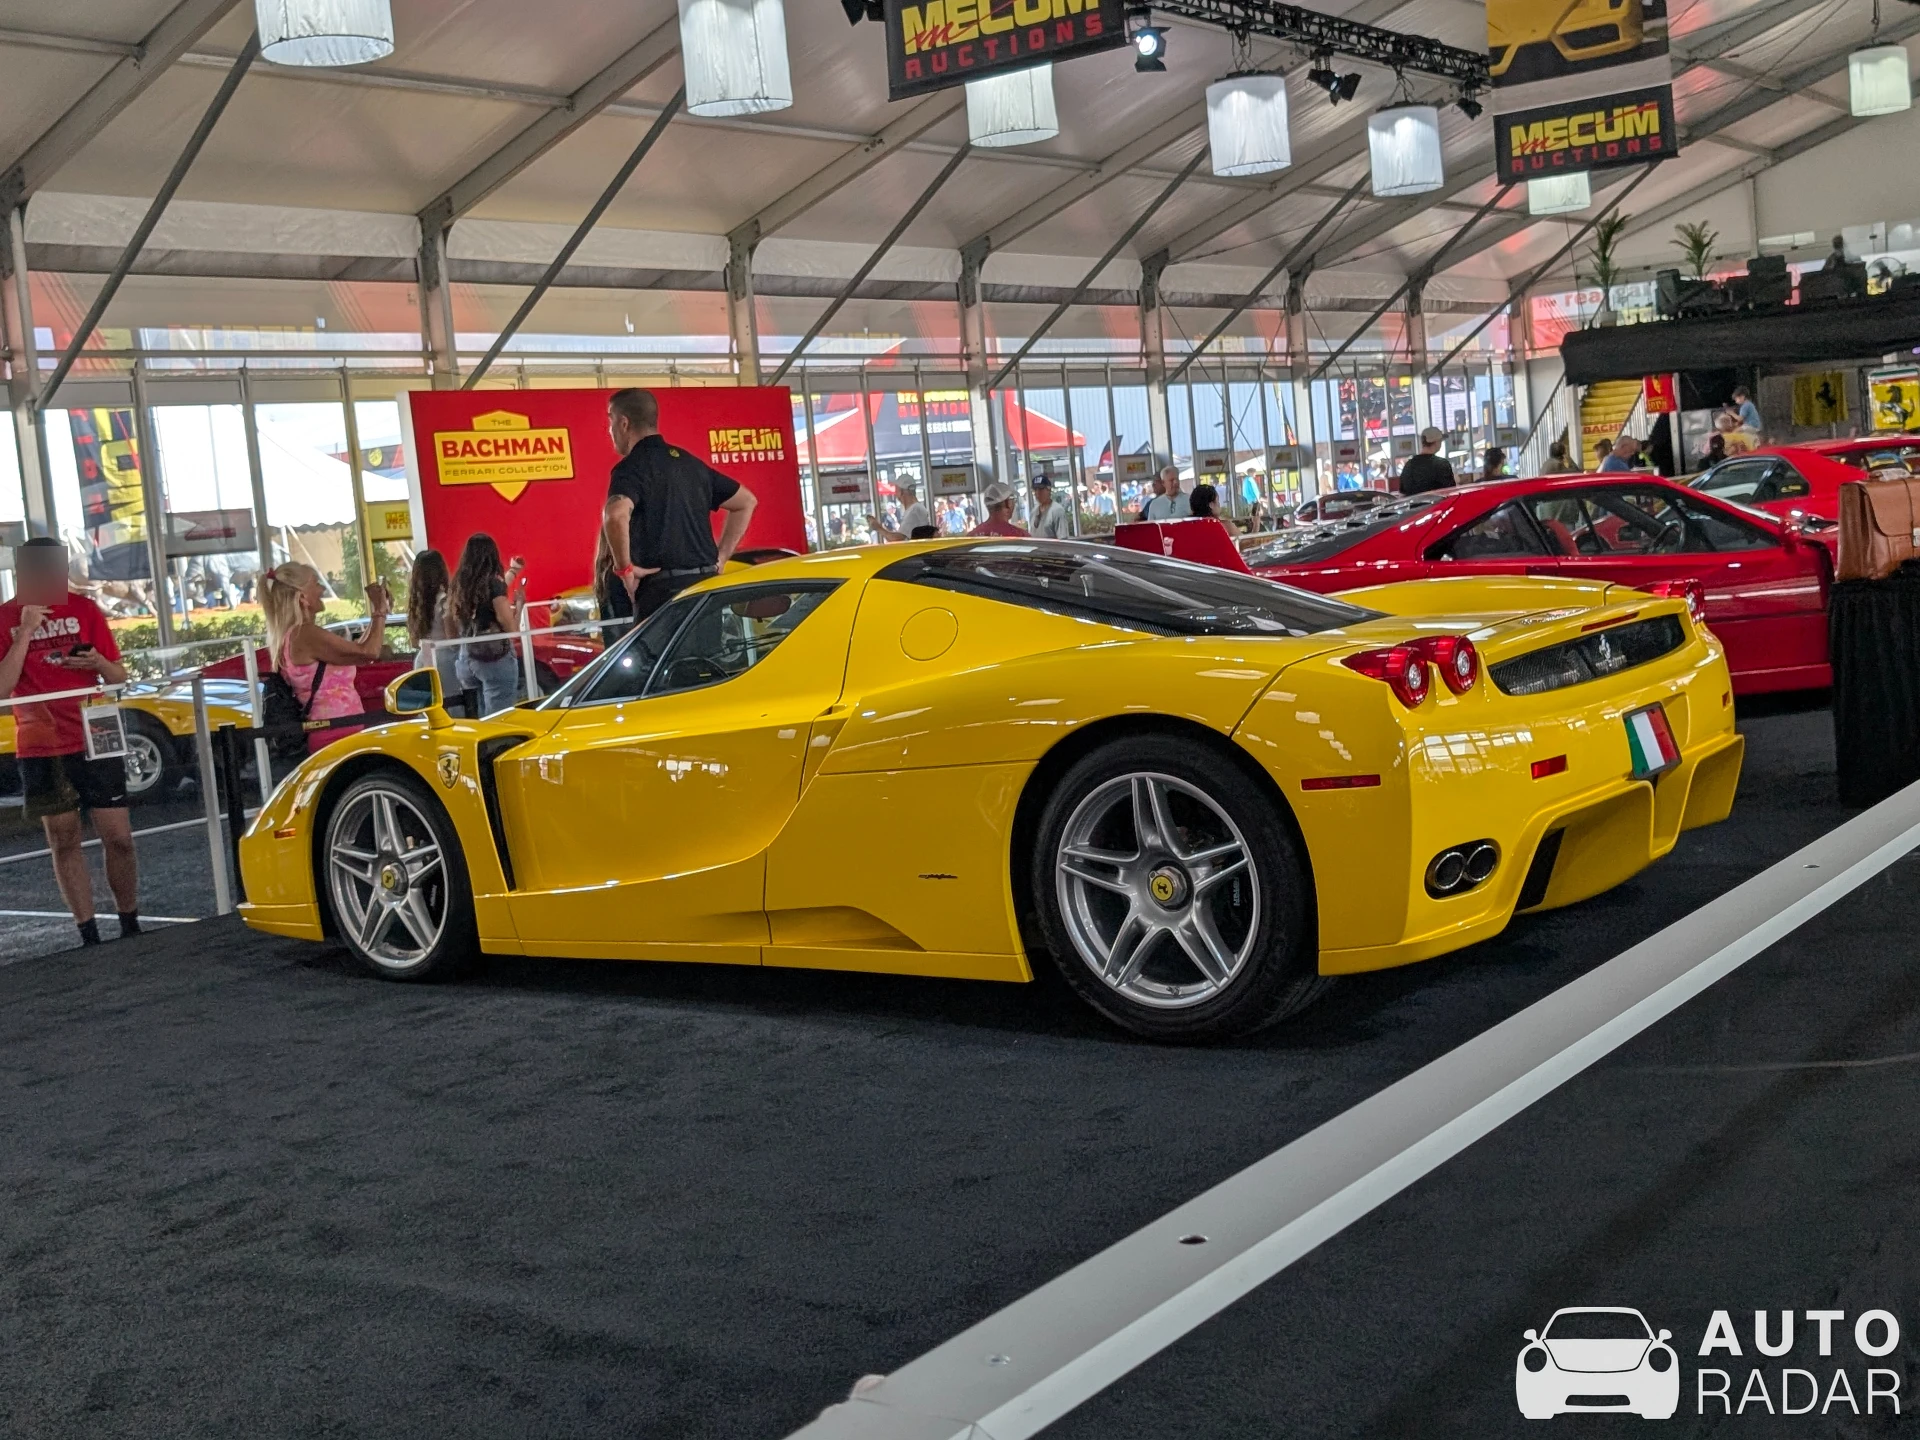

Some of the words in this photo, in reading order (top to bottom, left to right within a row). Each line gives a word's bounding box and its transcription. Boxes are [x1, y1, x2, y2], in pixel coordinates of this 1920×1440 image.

[904, 13, 1104, 80] AUCTIONS
[1510, 102, 1660, 157] MECUM
[1511, 136, 1662, 173] AUCTIONS
[441, 436, 565, 458] BACHMAN
[709, 428, 782, 452] MECUM
[711, 450, 784, 464] AUCTIONS
[499, 464, 568, 474] COLLECTION
[11, 617, 81, 640] AMS
